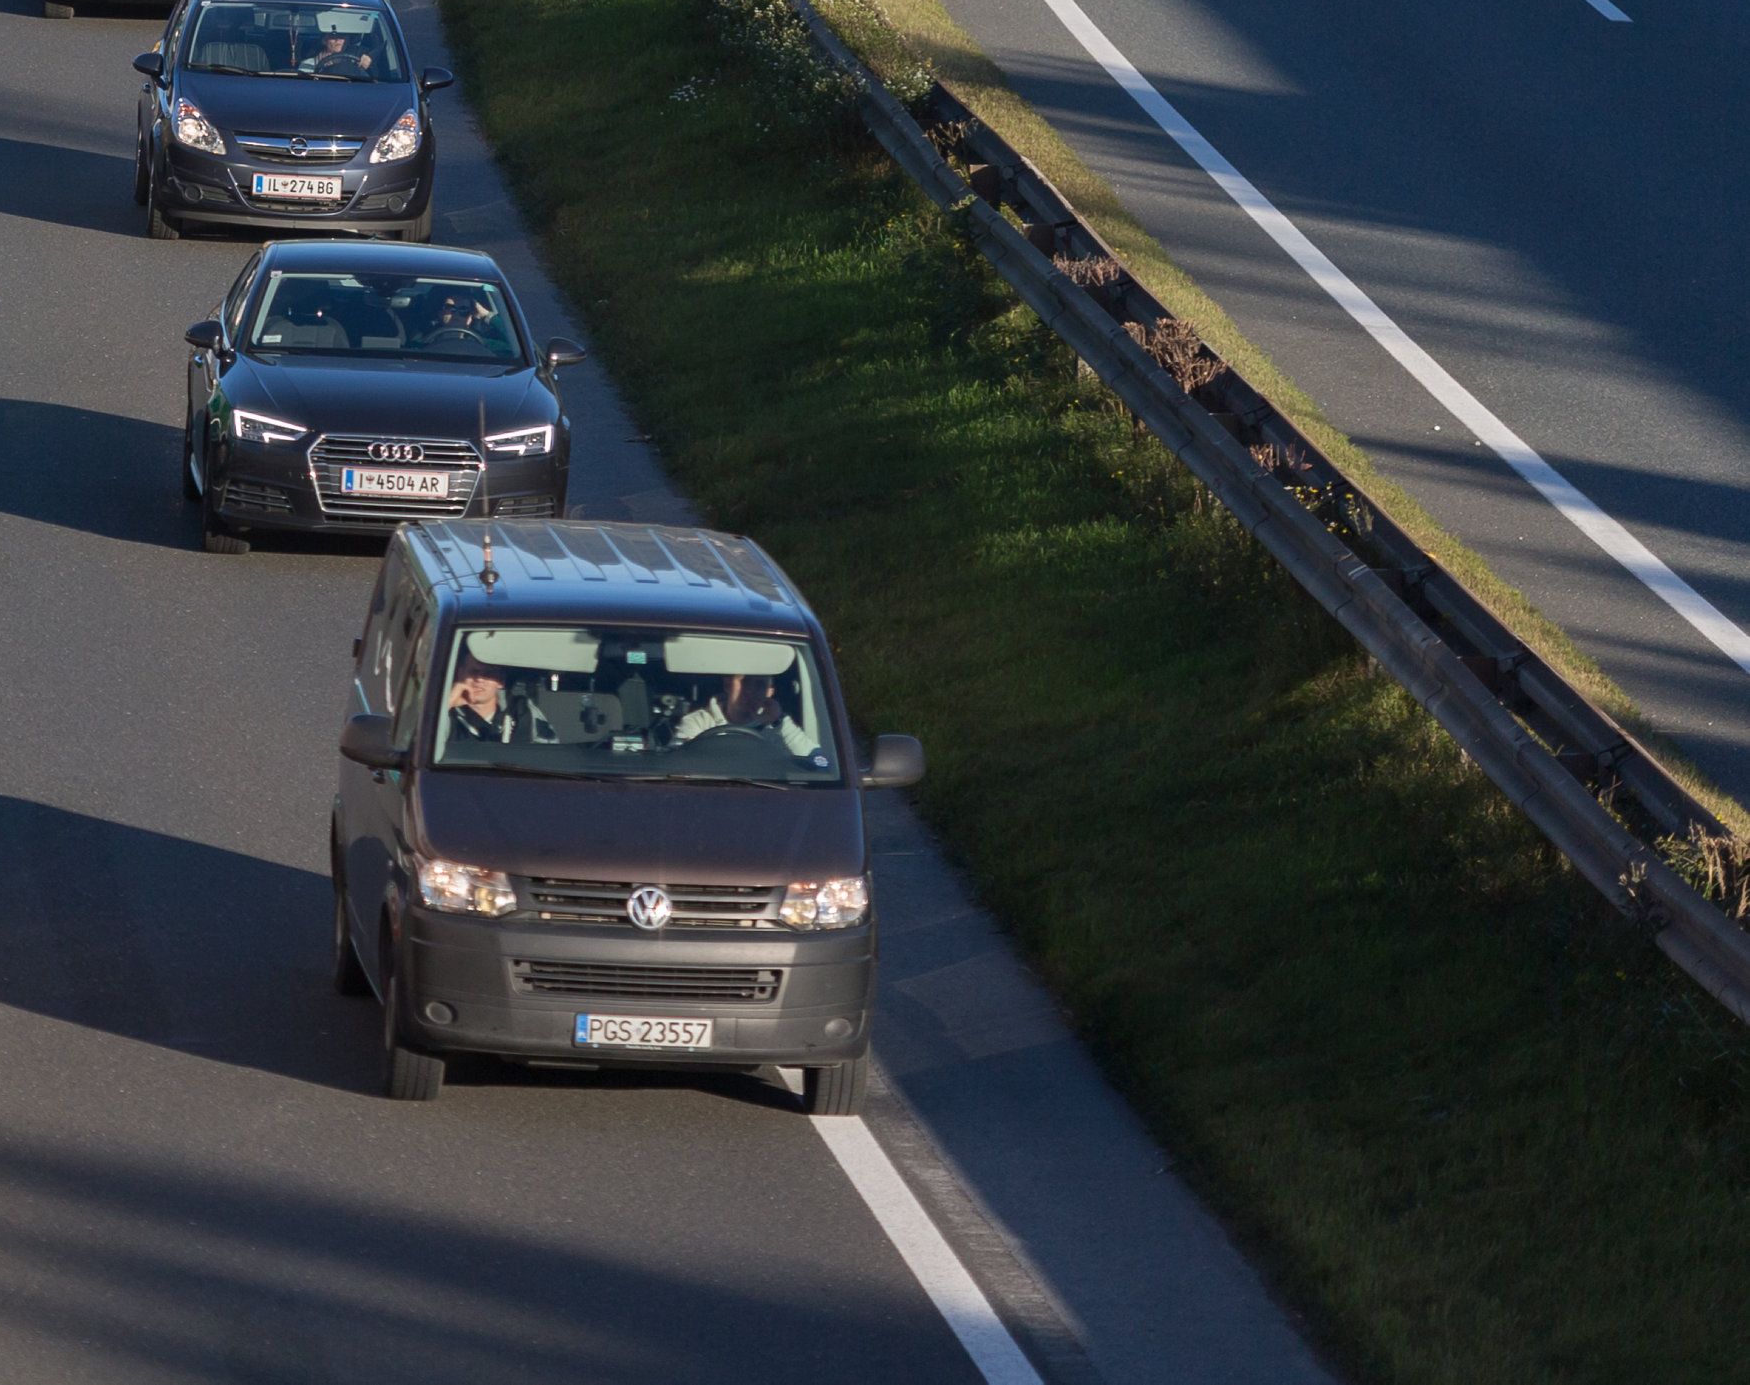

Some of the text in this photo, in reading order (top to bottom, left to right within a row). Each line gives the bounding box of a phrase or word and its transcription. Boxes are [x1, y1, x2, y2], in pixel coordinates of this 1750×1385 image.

[268, 178, 334, 195] IL 274 BG
[376, 474, 415, 491] 4504
[419, 477, 439, 493] AR
[590, 1018, 708, 1045] PGS 23557
